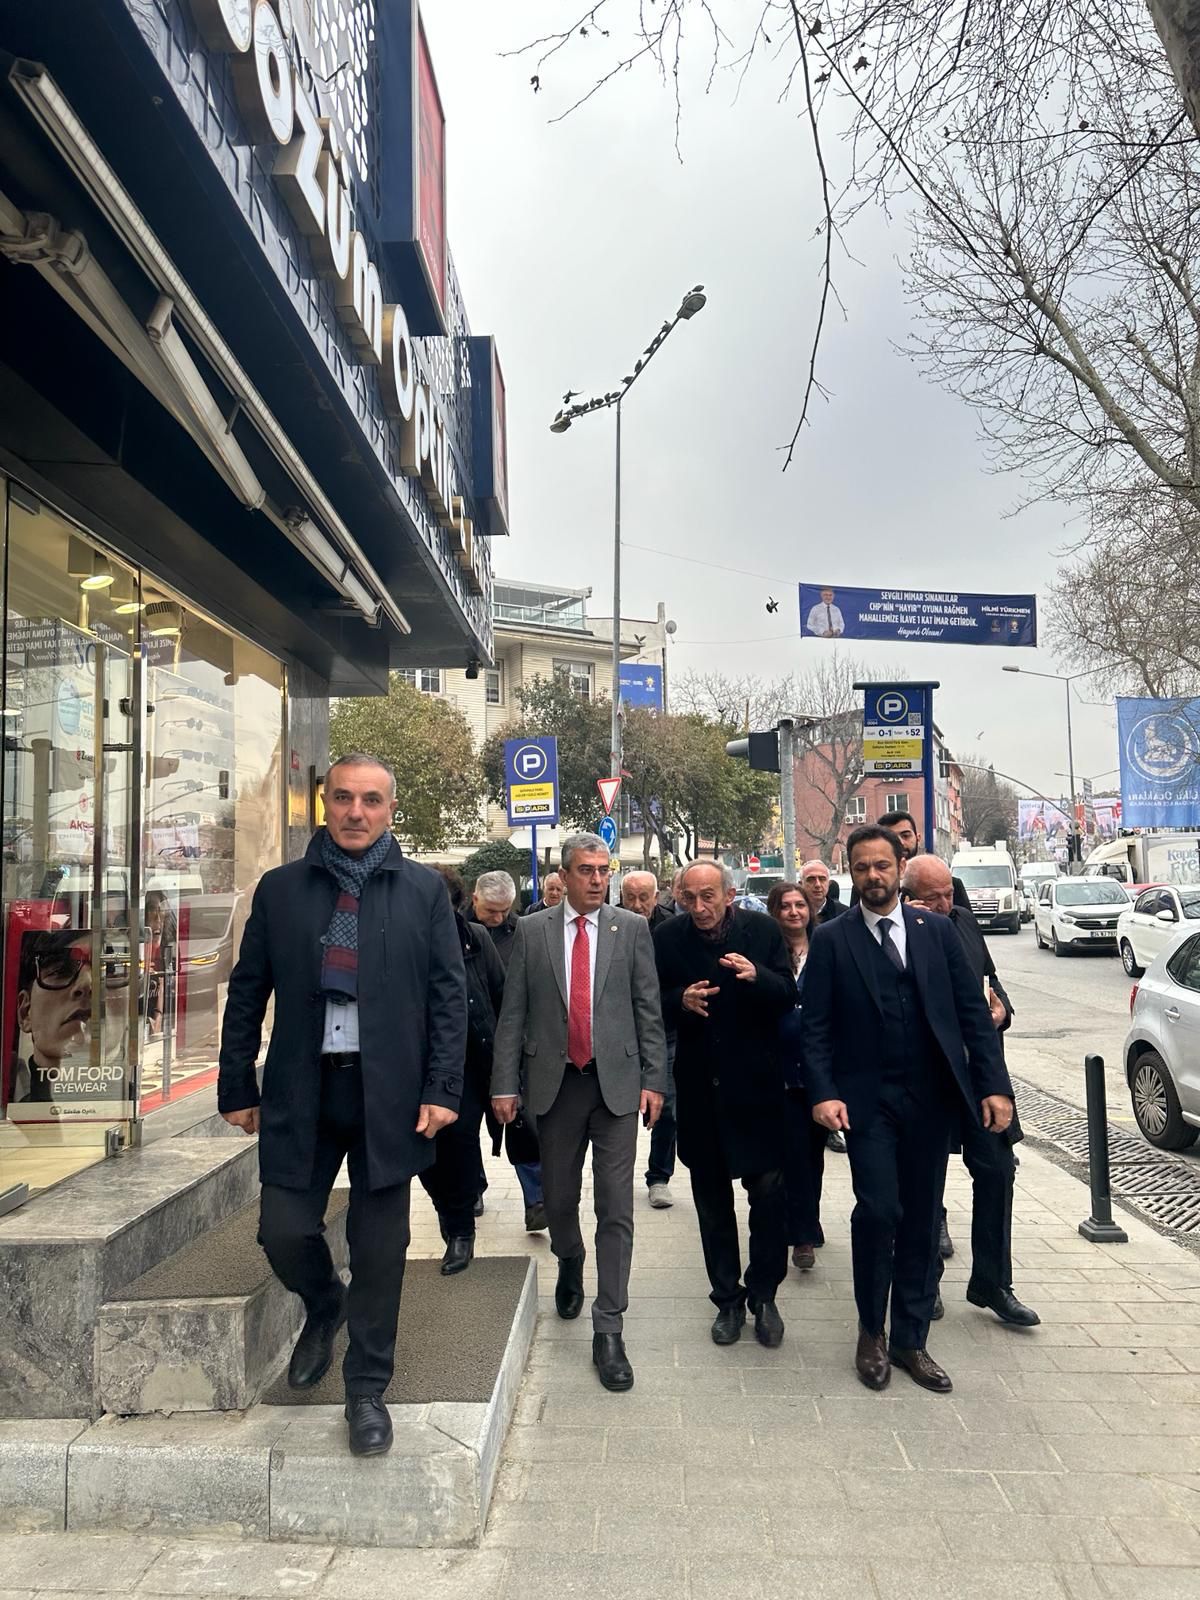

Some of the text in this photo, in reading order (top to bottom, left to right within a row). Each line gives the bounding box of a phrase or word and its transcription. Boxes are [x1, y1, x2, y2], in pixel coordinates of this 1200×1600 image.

[922, 605, 943, 614] OYUNA
[944, 604, 969, 616] RAĞMEN
[921, 615, 933, 624] KAT
[934, 615, 949, 625] İMAR
[37, 1066, 124, 1082] TOM FORD
[55, 1083, 107, 1093] EYEWEAR
